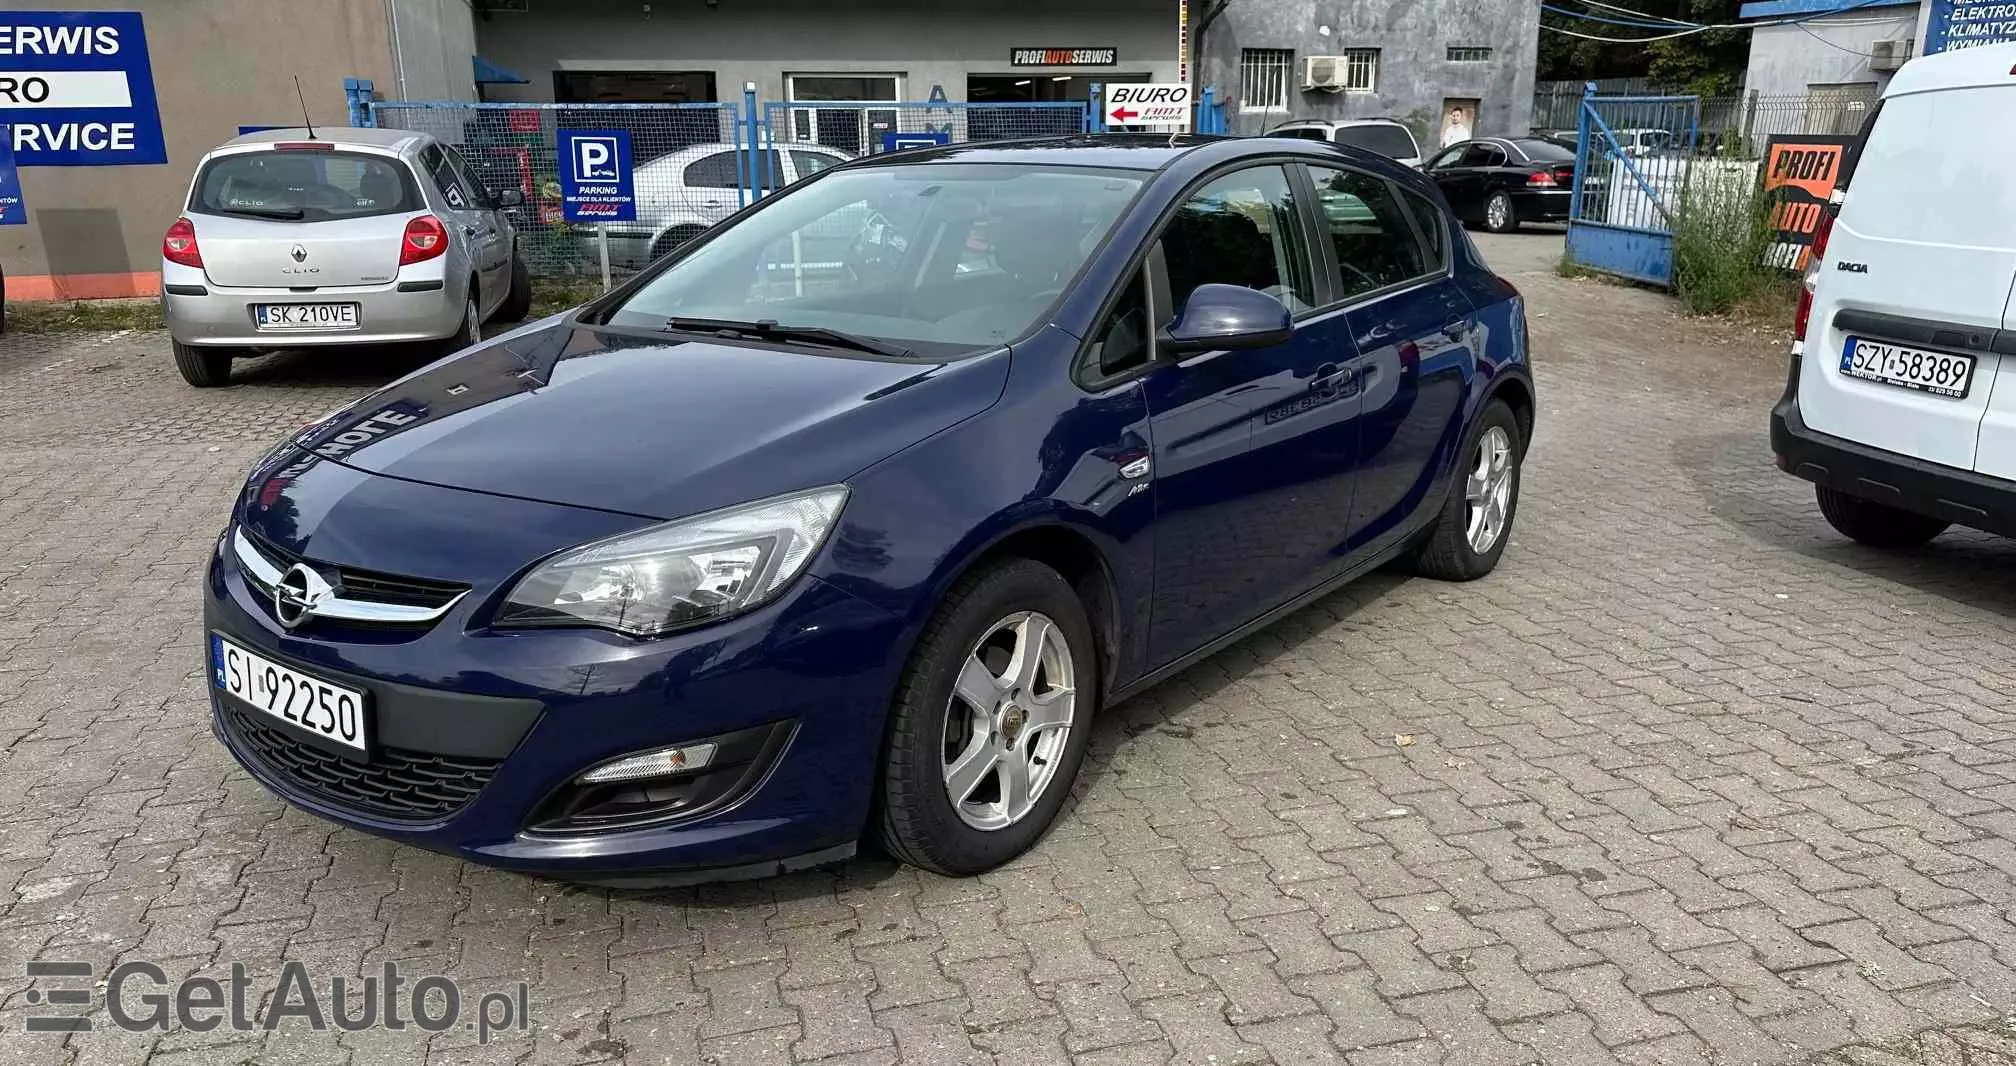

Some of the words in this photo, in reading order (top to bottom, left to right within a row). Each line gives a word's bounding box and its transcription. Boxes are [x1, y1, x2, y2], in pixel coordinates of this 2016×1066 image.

[1111, 88, 1188, 103] BIURO
[0, 122, 135, 152] RVICE
[581, 143, 609, 177] P
[1773, 150, 1836, 180] PROFI
[579, 186, 618, 195] PARKING
[1767, 201, 1822, 233] AUTO
[1837, 261, 1868, 274] DACIA
[271, 307, 292, 323] SK
[299, 305, 352, 322] 210VE
[1853, 343, 1893, 374] SZY
[1895, 350, 1967, 387] 58389
[216, 668, 226, 683] PL
[228, 648, 253, 701] SI
[265, 666, 357, 742] 92250
